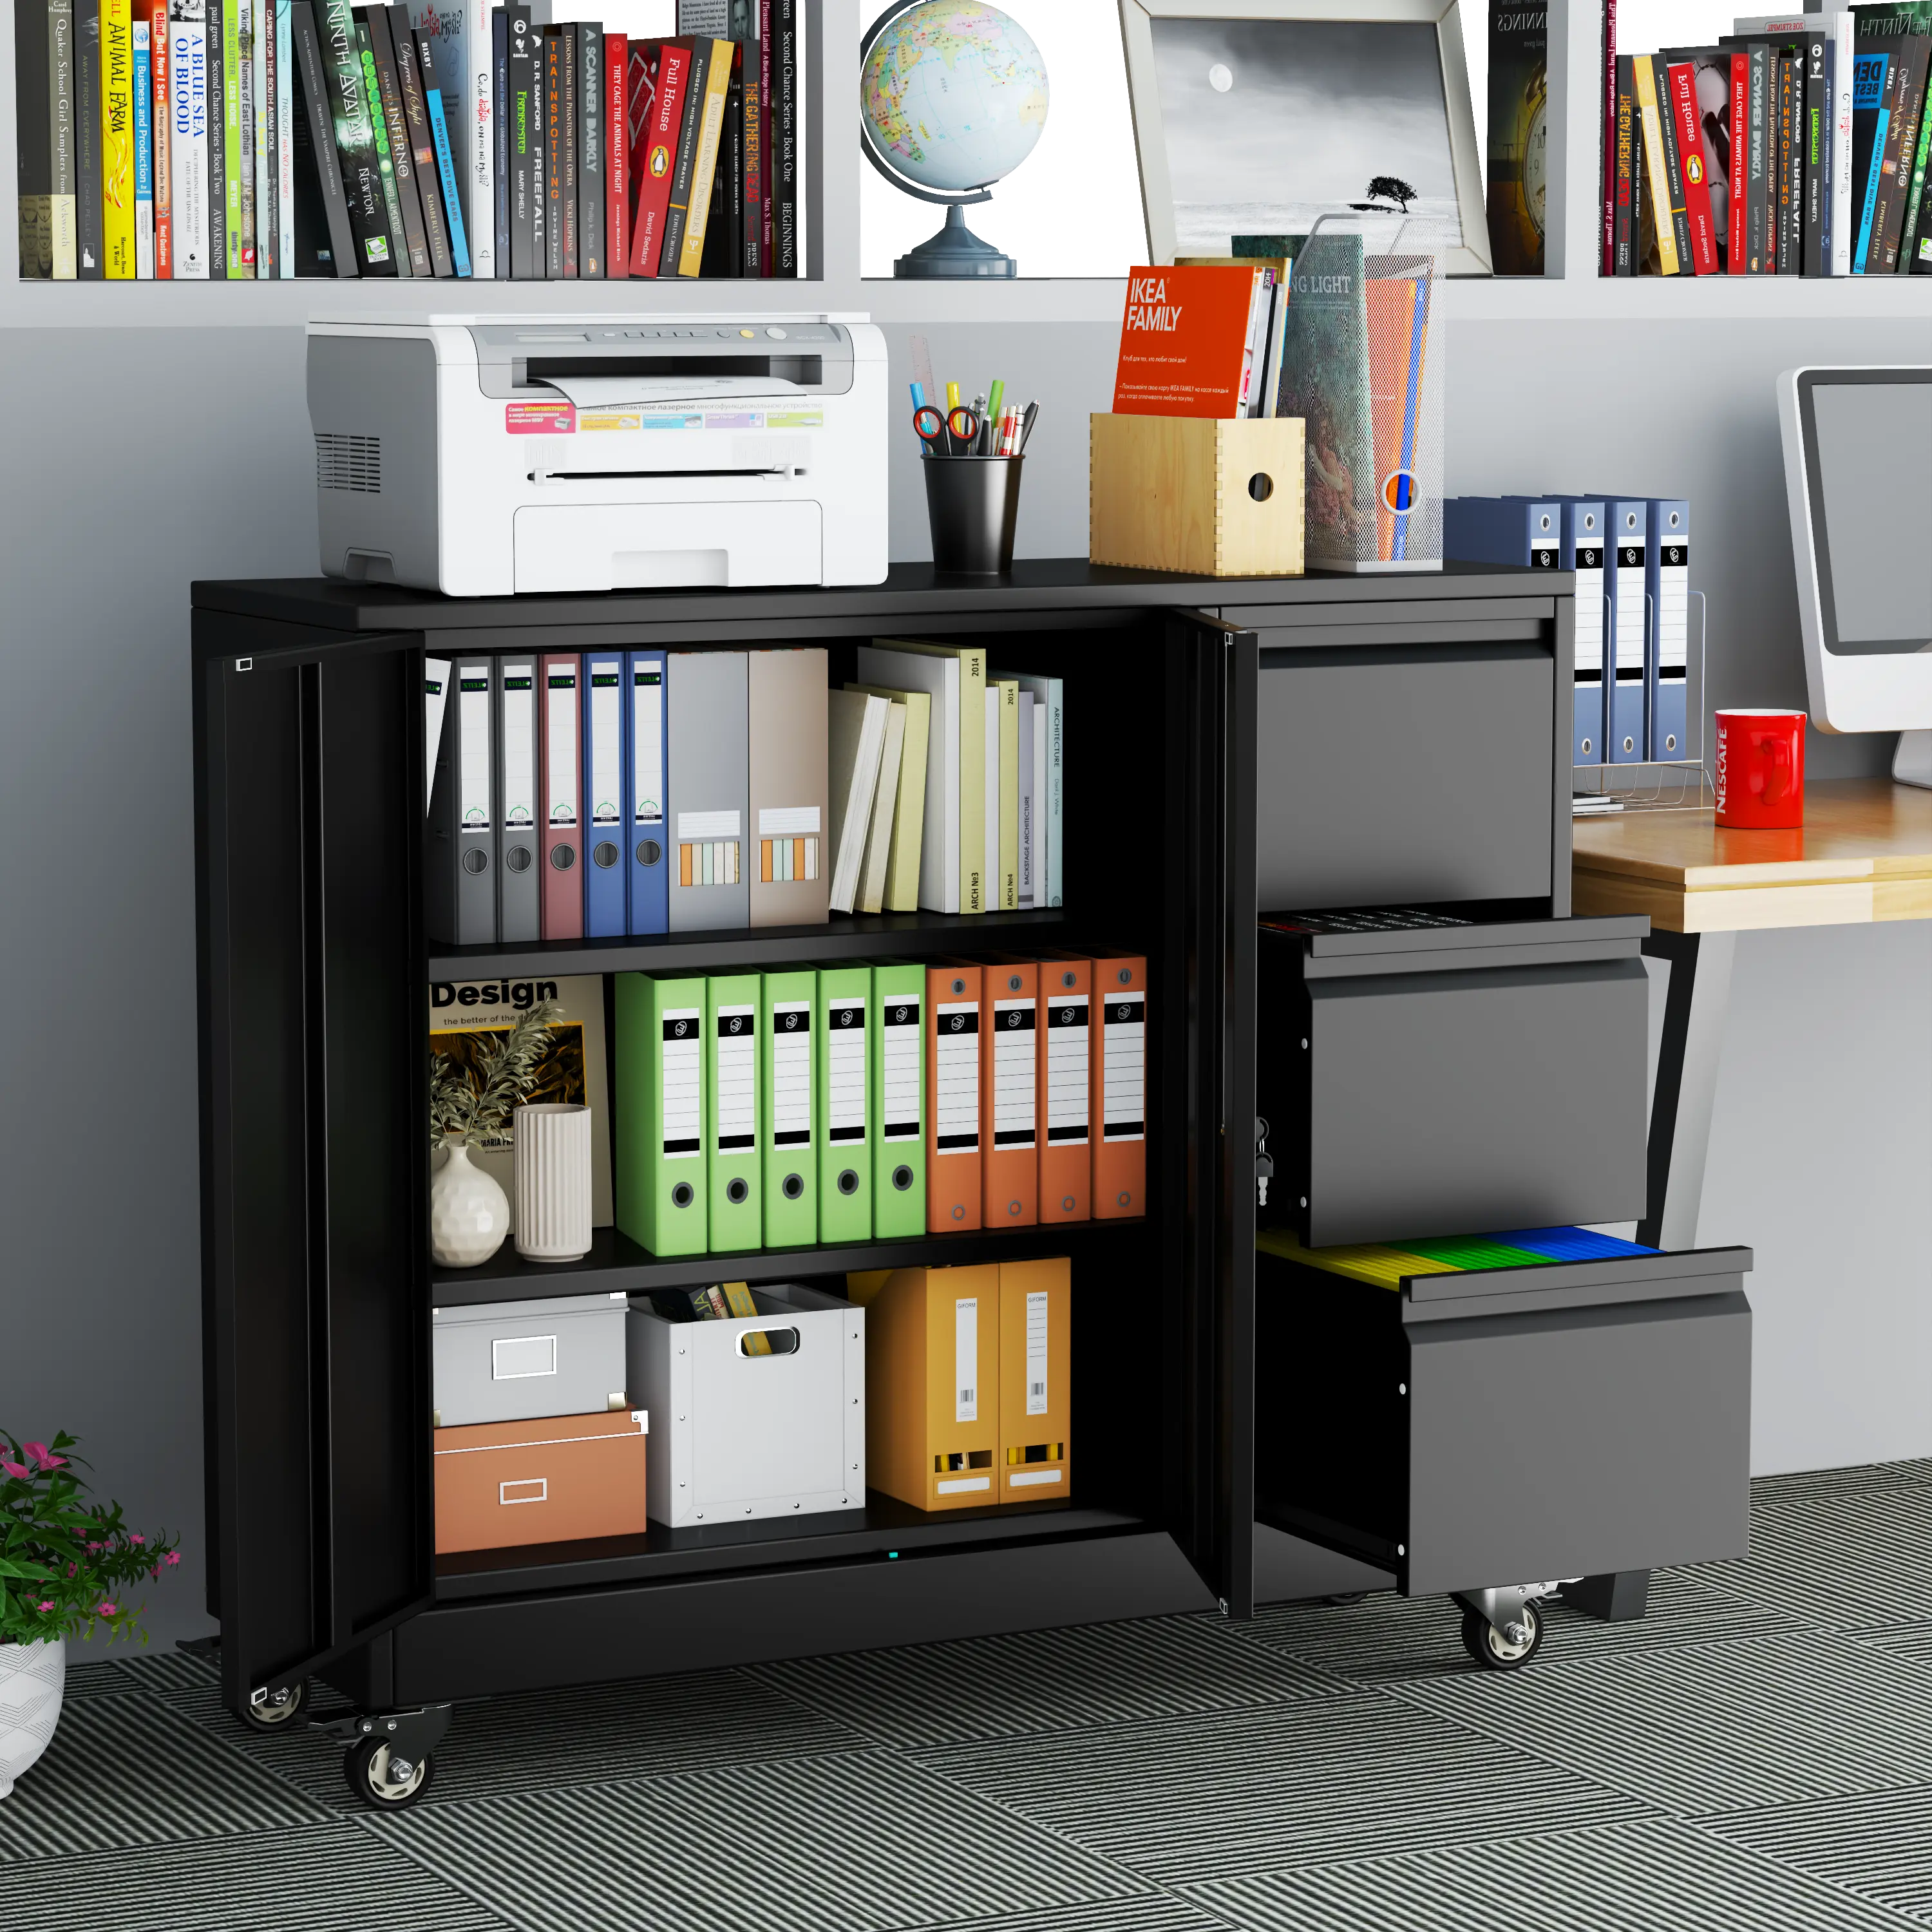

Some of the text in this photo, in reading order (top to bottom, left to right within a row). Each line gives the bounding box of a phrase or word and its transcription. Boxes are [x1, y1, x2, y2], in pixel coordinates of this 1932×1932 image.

[156, 13, 165, 35] Blind
[209, 6, 220, 48] paul green
[240, 8, 249, 35] Viking
[55, 19, 67, 57] Quaker
[156, 39, 165, 55] But
[176, 38, 189, 62] OF
[156, 57, 165, 75] Now
[422, 42, 432, 68] BIXBY
[58, 61, 67, 95] School
[108, 21, 128, 133] ANIMAL FARM
[157, 84, 166, 100] See
[192, 34, 205, 138] A BLUE SEA
[746, 82, 758, 104] THE
[59, 99, 68, 122] Girl
[176, 68, 189, 133] BLOOD
[242, 92, 250, 102] of
[585, 29, 597, 173] A SCANNER DARKLY
[660, 58, 680, 131] Full House
[783, 32, 793, 182] Second Chance Series Book One
[138, 66, 148, 183] Business and Production
[212, 60, 222, 194] Second Chance Series Book Two
[550, 42, 559, 199] TRAINSPOTTING
[57, 126, 68, 172] Samplers
[242, 124, 251, 155] Lothian
[566, 138, 573, 147] OF
[746, 106, 759, 171] GATHERING
[614, 158, 621, 168] AT
[358, 167, 375, 217] NEWTON
[746, 173, 759, 203] DEAD
[213, 209, 223, 269] AWAKENING
[641, 211, 655, 265] David Sedaris
[782, 202, 792, 268] BEGINNINGS
[1130, 278, 1166, 303] IKEA
[1311, 276, 1351, 294] LIGHT
[1126, 306, 1182, 332] FAMILY
[431, 980, 558, 1010] Design
